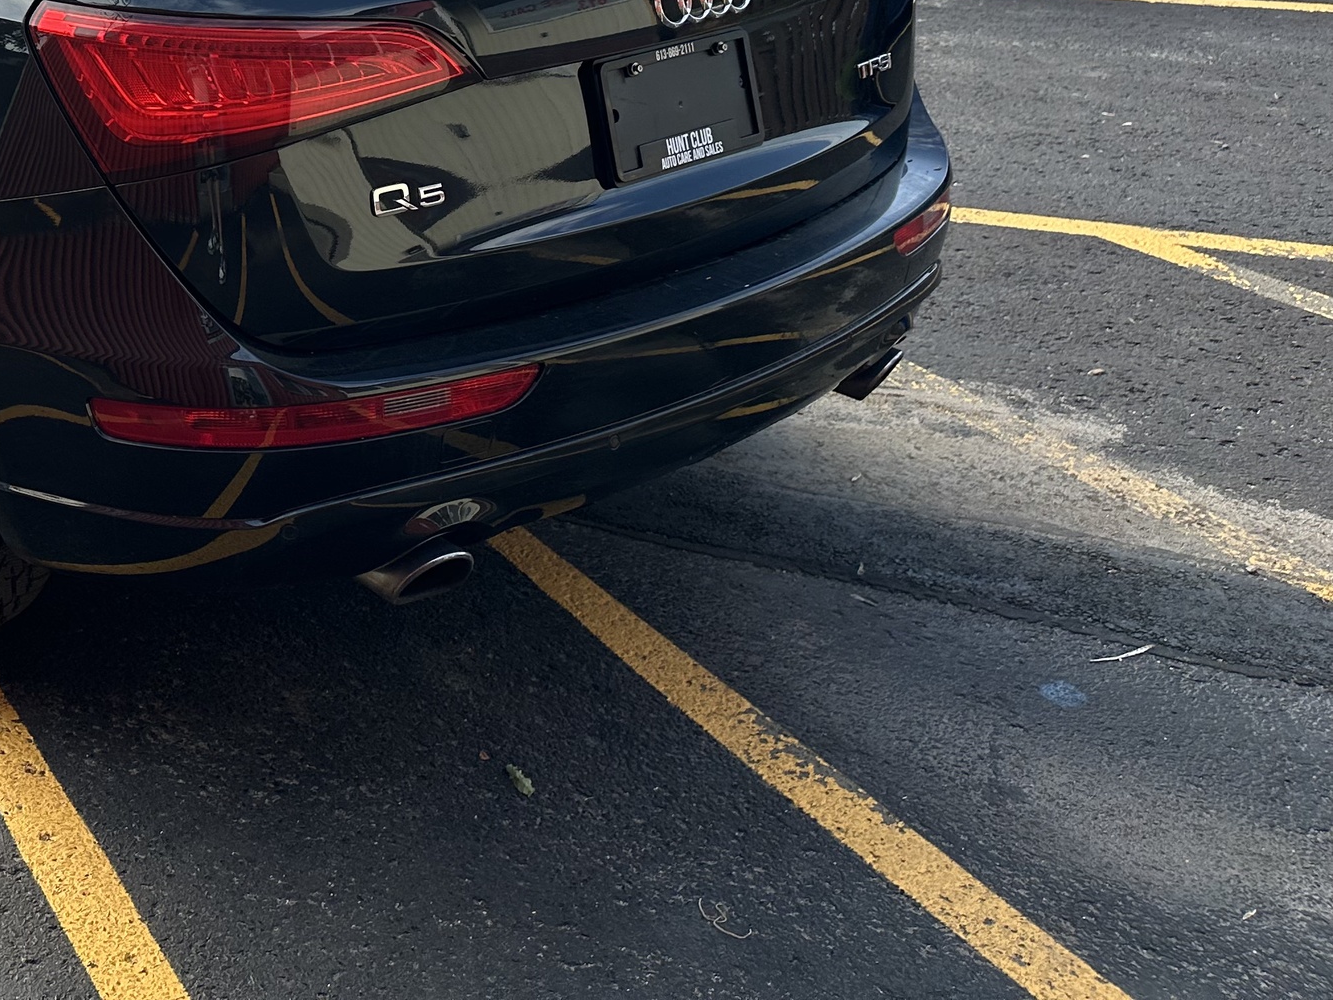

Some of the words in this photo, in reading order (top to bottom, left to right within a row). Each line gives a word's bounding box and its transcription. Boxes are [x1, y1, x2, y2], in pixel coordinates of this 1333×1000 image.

[661, 155, 677, 170] AUTO
[677, 150, 693, 166] CARE
[692, 146, 706, 161] AND
[705, 141, 724, 157] SALES
[665, 133, 689, 156] HUNT
[690, 127, 714, 149] CLUB
[371, 182, 446, 218] Q5
